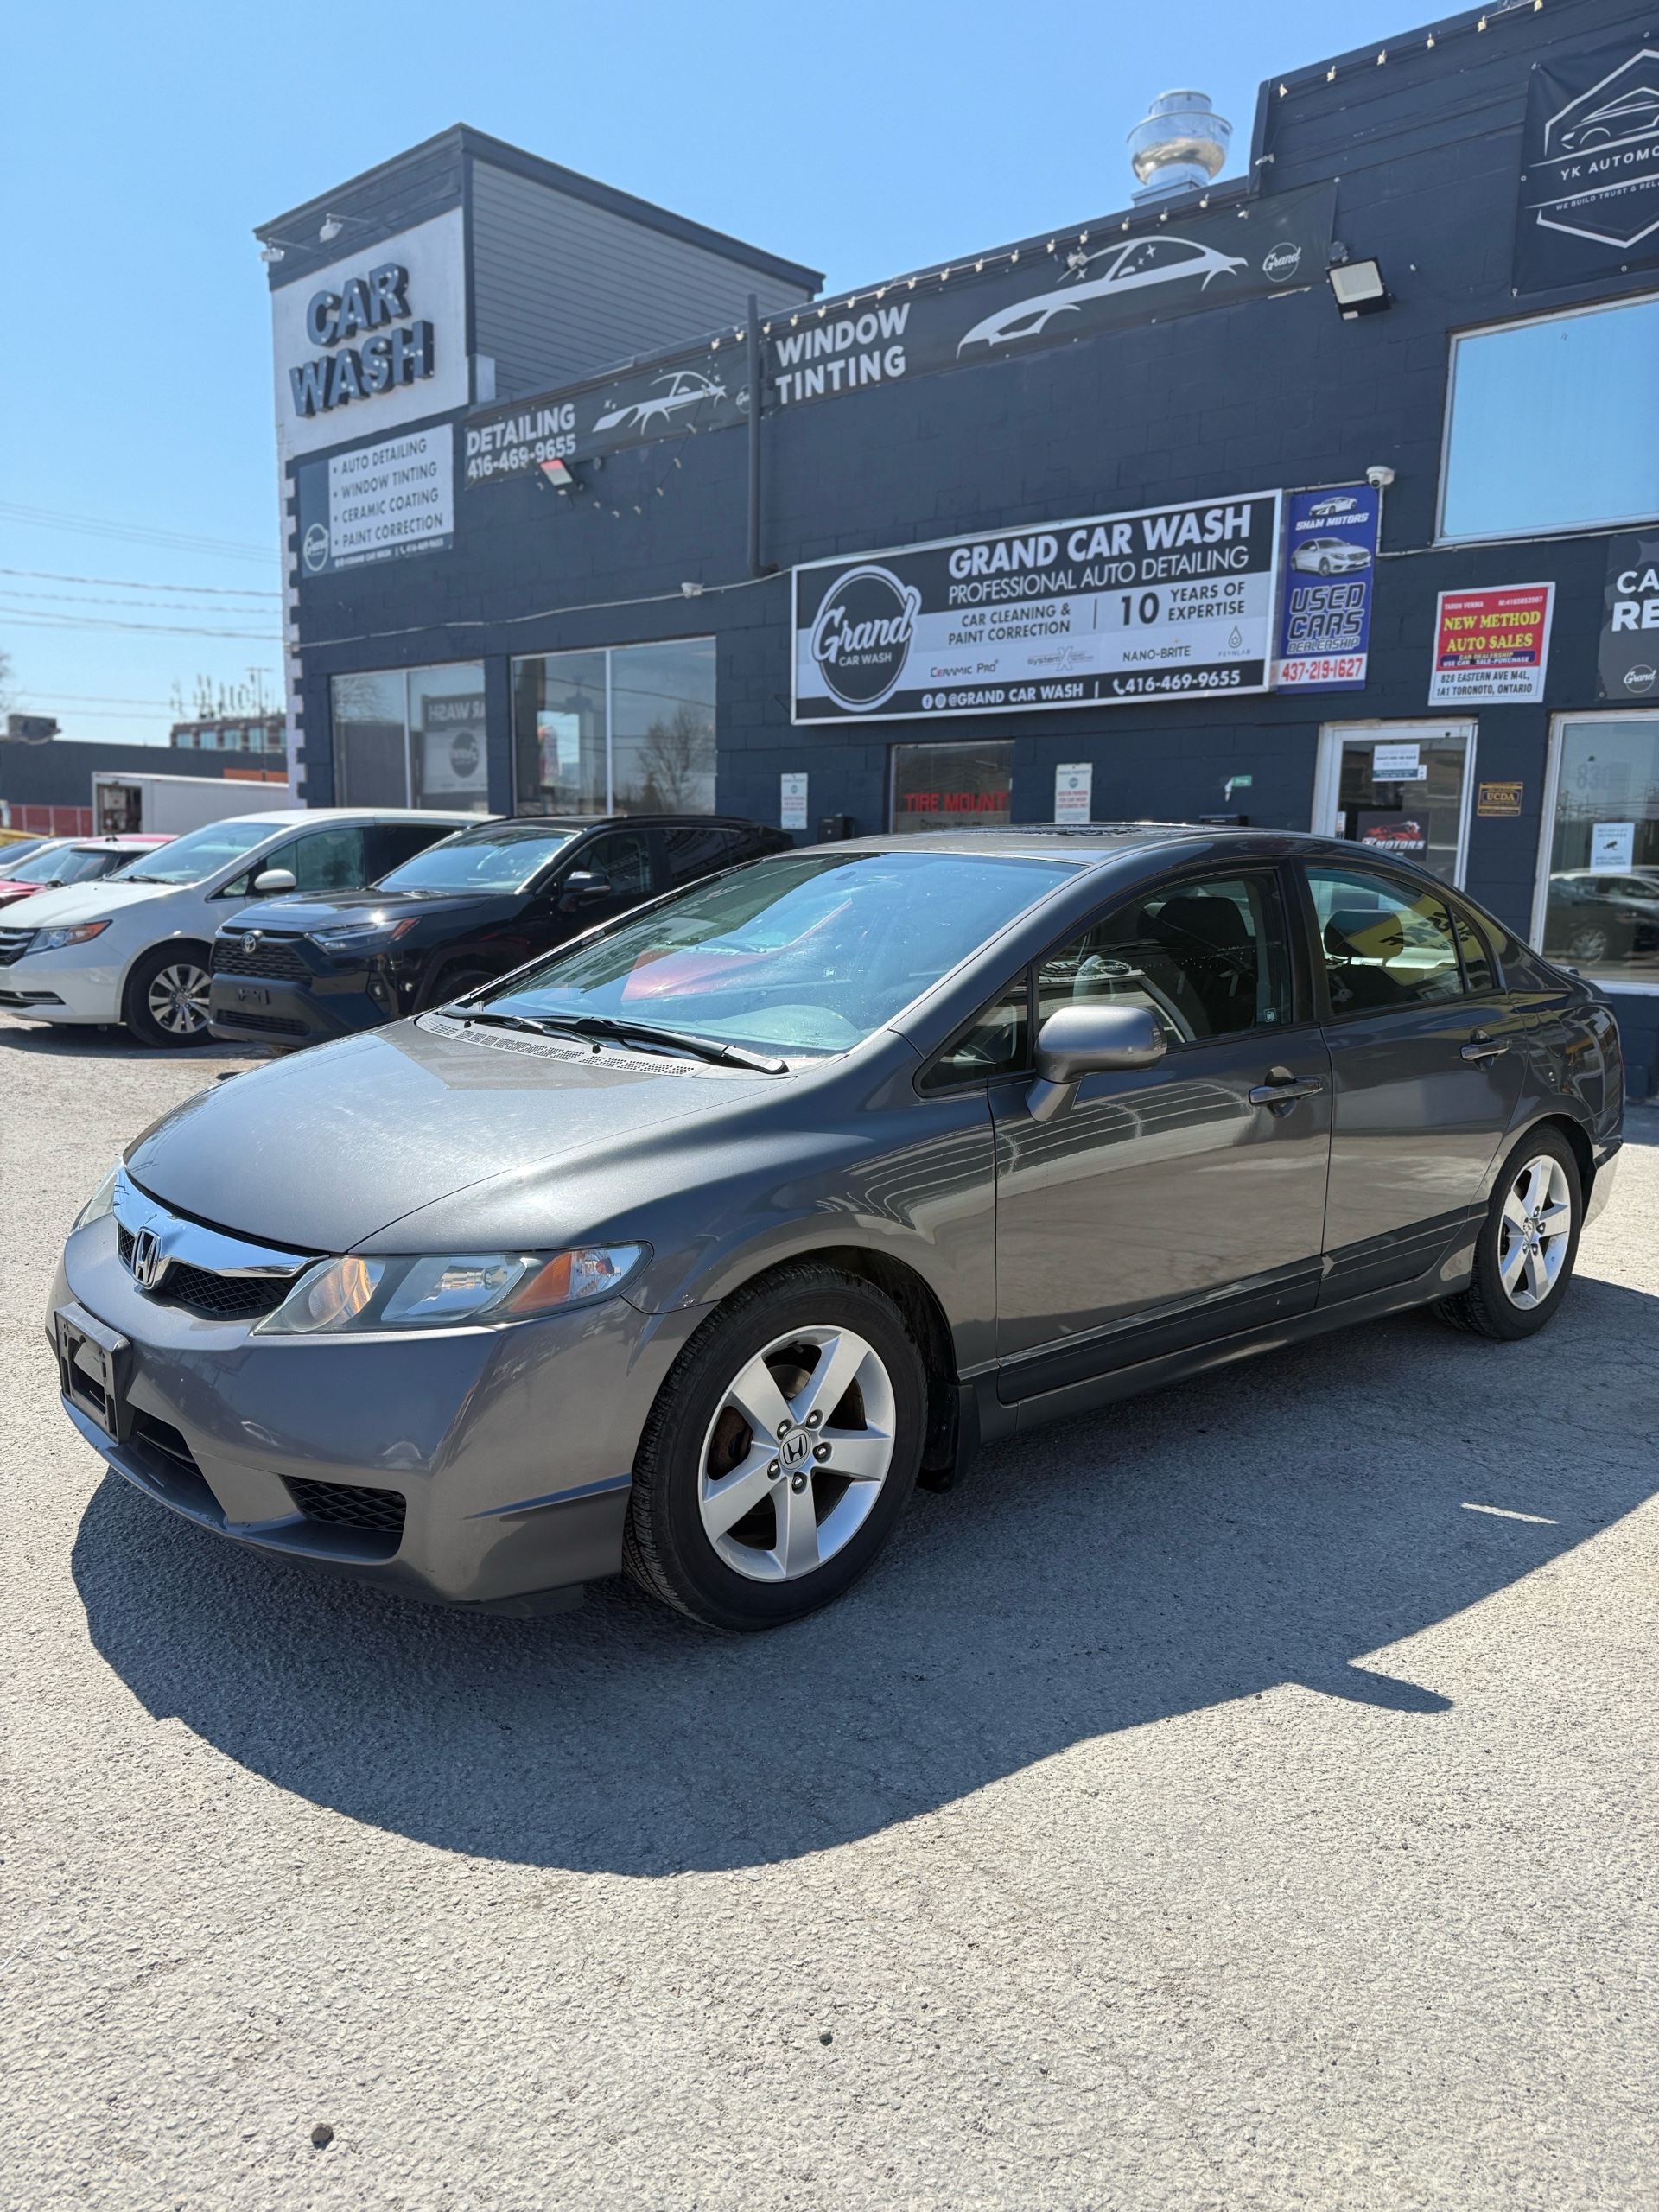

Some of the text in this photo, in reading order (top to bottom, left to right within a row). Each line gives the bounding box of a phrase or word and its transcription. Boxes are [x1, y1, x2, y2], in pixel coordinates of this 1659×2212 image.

[1560, 166, 1581, 181] YK
[1556, 202, 1568, 211] WE
[1571, 195, 1596, 207] BUILD
[1599, 188, 1627, 200] TRUST
[1262, 246, 1302, 271] Grand
[307, 262, 412, 347] CAR
[775, 302, 911, 368] WINDOW
[289, 320, 435, 418] WASH
[775, 345, 906, 405] TINTING
[467, 403, 575, 456] DETAILING
[341, 438, 427, 475] AUTO DETAILING
[467, 433, 576, 479] 416-469-9655
[341, 461, 437, 499] WINDOW TINTING
[342, 487, 439, 524] CERAMIC COATING
[343, 529, 372, 548] PAINT
[375, 512, 443, 541] CORRECTION
[1295, 512, 1370, 531] SHAM MOTORS
[949, 504, 1251, 580] GRAND CAR WASH
[949, 545, 1249, 605] PROFESSIONAL AUTO DETAILING
[1170, 581, 1245, 603] YEARS OF
[1289, 582, 1366, 615] USED
[962, 602, 1071, 627] CAR CLEANING &
[1122, 592, 1160, 626] 10
[1168, 600, 1245, 622] EXPERTISE
[1443, 611, 1541, 631] NEW METHOD
[1611, 598, 1659, 632] RE
[812, 593, 916, 664] Grand
[949, 620, 1071, 646] PAINT CORRECTION
[1287, 609, 1364, 640] CARS
[1123, 645, 1192, 662] NANO-BRITE
[1218, 649, 1250, 658] FEYNLAB
[1287, 636, 1360, 655] DEALERSHIP
[1446, 633, 1533, 652] AUTO SALES
[839, 652, 892, 667] CAR WASH
[1281, 658, 1363, 682] 437-219-1627
[1476, 657, 1529, 665] SALE-PURCHASE
[1125, 670, 1241, 693] 416-469-9655
[1441, 671, 1530, 683] 828 EASTERN AVE M4L,
[1624, 669, 1657, 684] Grand
[948, 683, 1084, 707] @GRAND CAR WASH
[1437, 683, 1532, 696] 1A1 TORONOTO, ONTARIO
[904, 791, 1010, 812] TIRE MOUNT
[1486, 792, 1515, 801] UCDA
[1375, 840, 1426, 849] MOTORS
